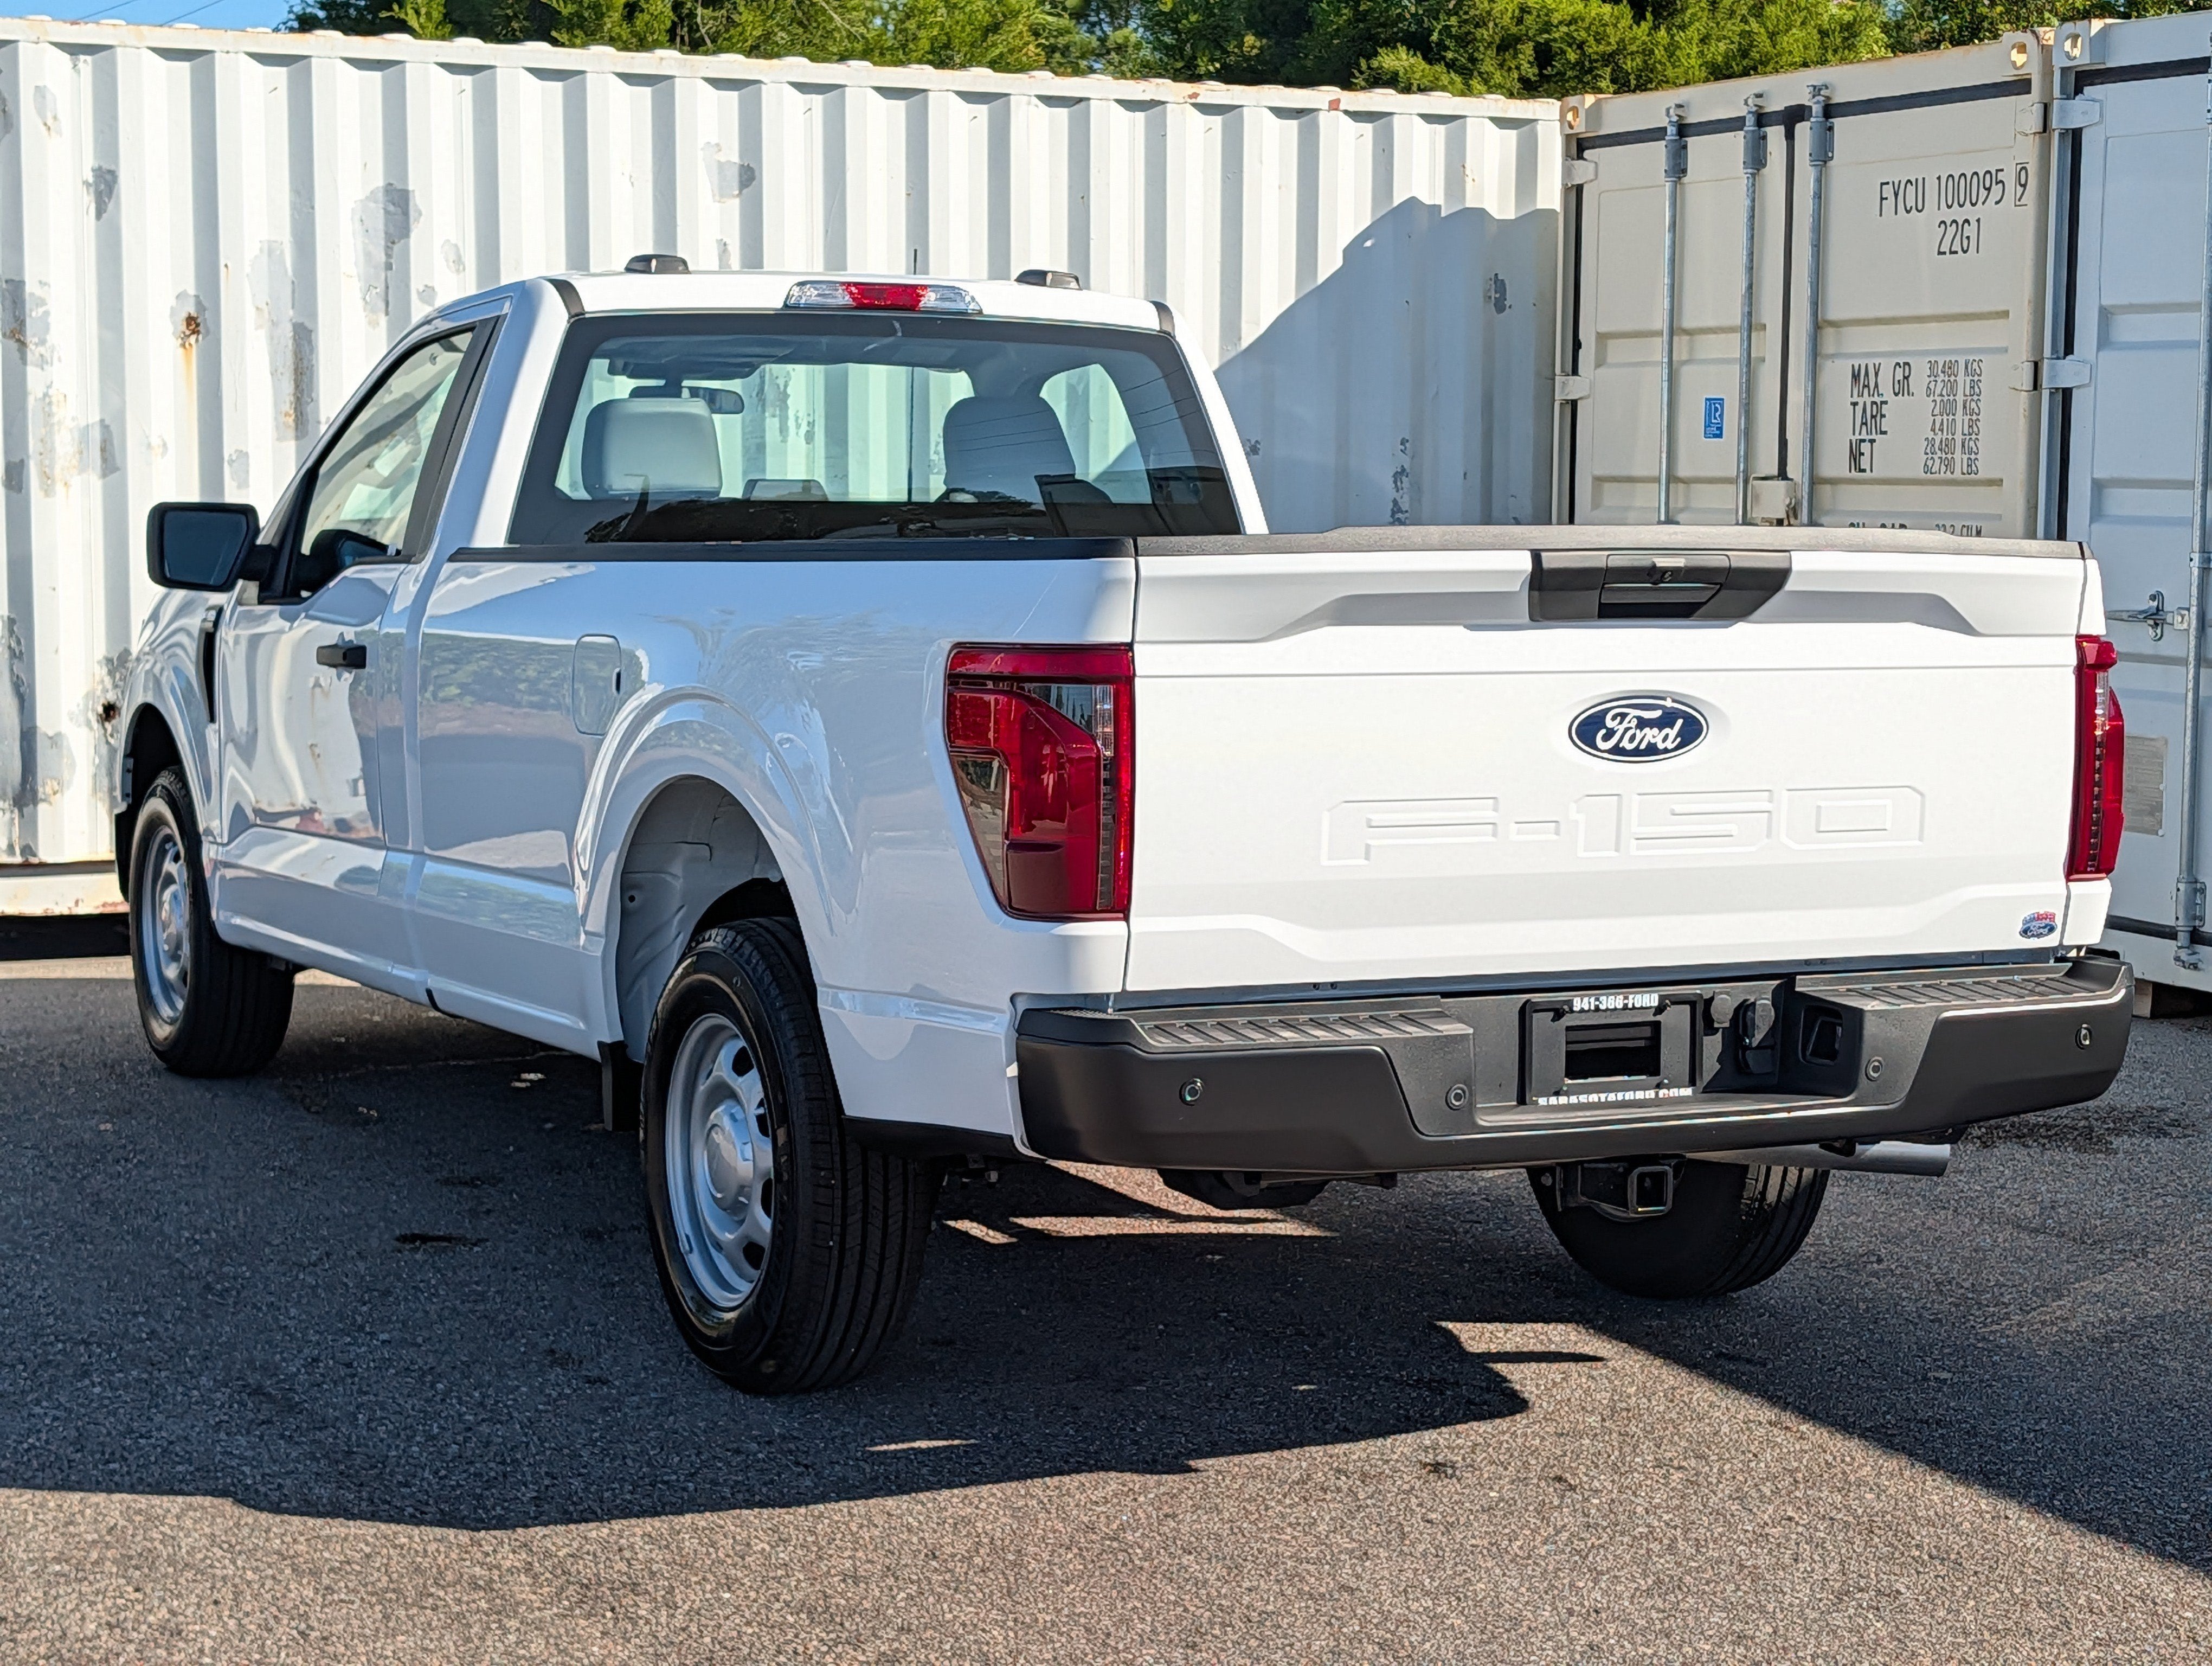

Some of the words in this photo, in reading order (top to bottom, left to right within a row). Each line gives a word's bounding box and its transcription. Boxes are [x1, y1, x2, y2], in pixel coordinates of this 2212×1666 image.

[1879, 177, 1926, 217] FYCU
[1936, 168, 2006, 211] 100095
[2017, 165, 2029, 202] 9
[1937, 217, 1981, 256] 22G1
[1964, 358, 1983, 377] KGS
[1850, 362, 1884, 399] MAX.
[1892, 361, 1914, 397] GR.
[1963, 379, 1982, 397] LBS
[1962, 398, 1982, 416] KGS
[1850, 400, 1888, 436] TARE
[1961, 418, 1980, 436] LBS
[1849, 438, 1876, 473] NET
[1960, 437, 1979, 456] KGS
[1960, 457, 1979, 475] LBS
[1596, 708, 1681, 751] Ford
[1321, 785, 1925, 866] F-150
[1573, 993, 1659, 1011] 941-366-FORD
[1538, 1087, 1693, 1105] SARASOTAFORDCOM
